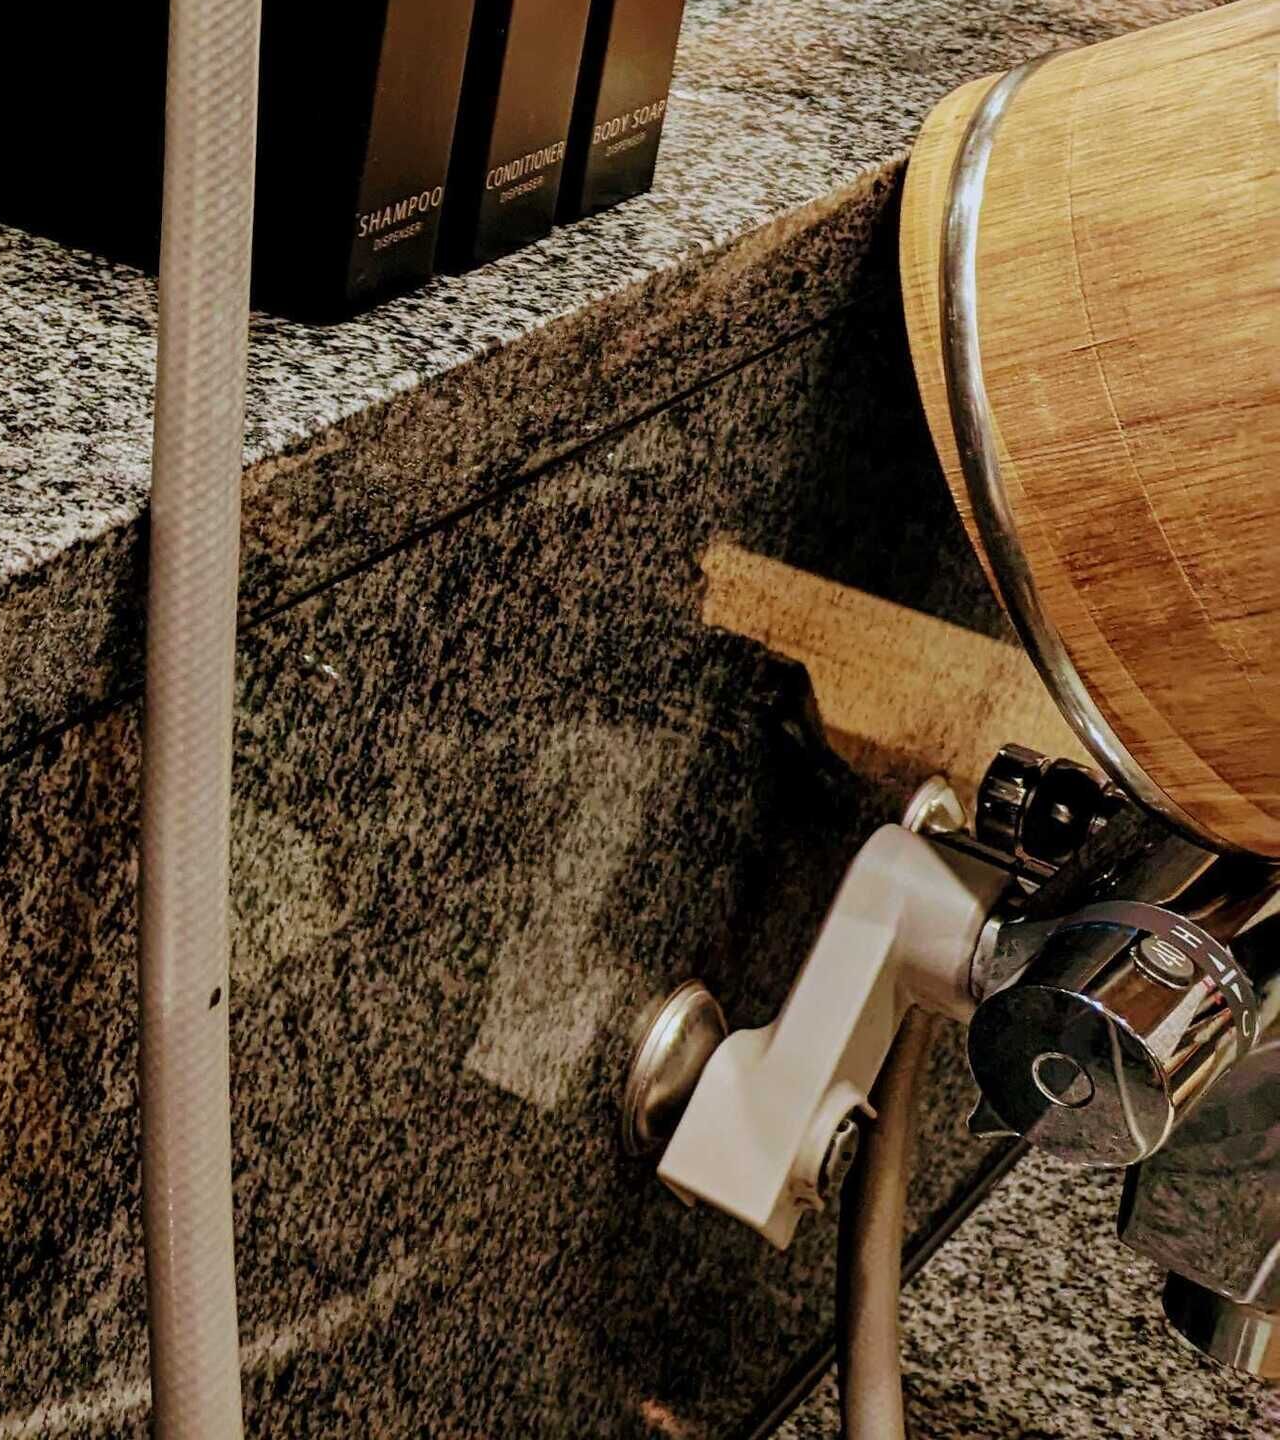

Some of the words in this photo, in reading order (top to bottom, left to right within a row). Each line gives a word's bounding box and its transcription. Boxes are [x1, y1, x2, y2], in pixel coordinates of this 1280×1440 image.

[593, 113, 630, 144] BODY
[631, 100, 666, 129] SOAP
[486, 141, 566, 190] CONDITIONER
[357, 186, 443, 237] SHAMPOO
